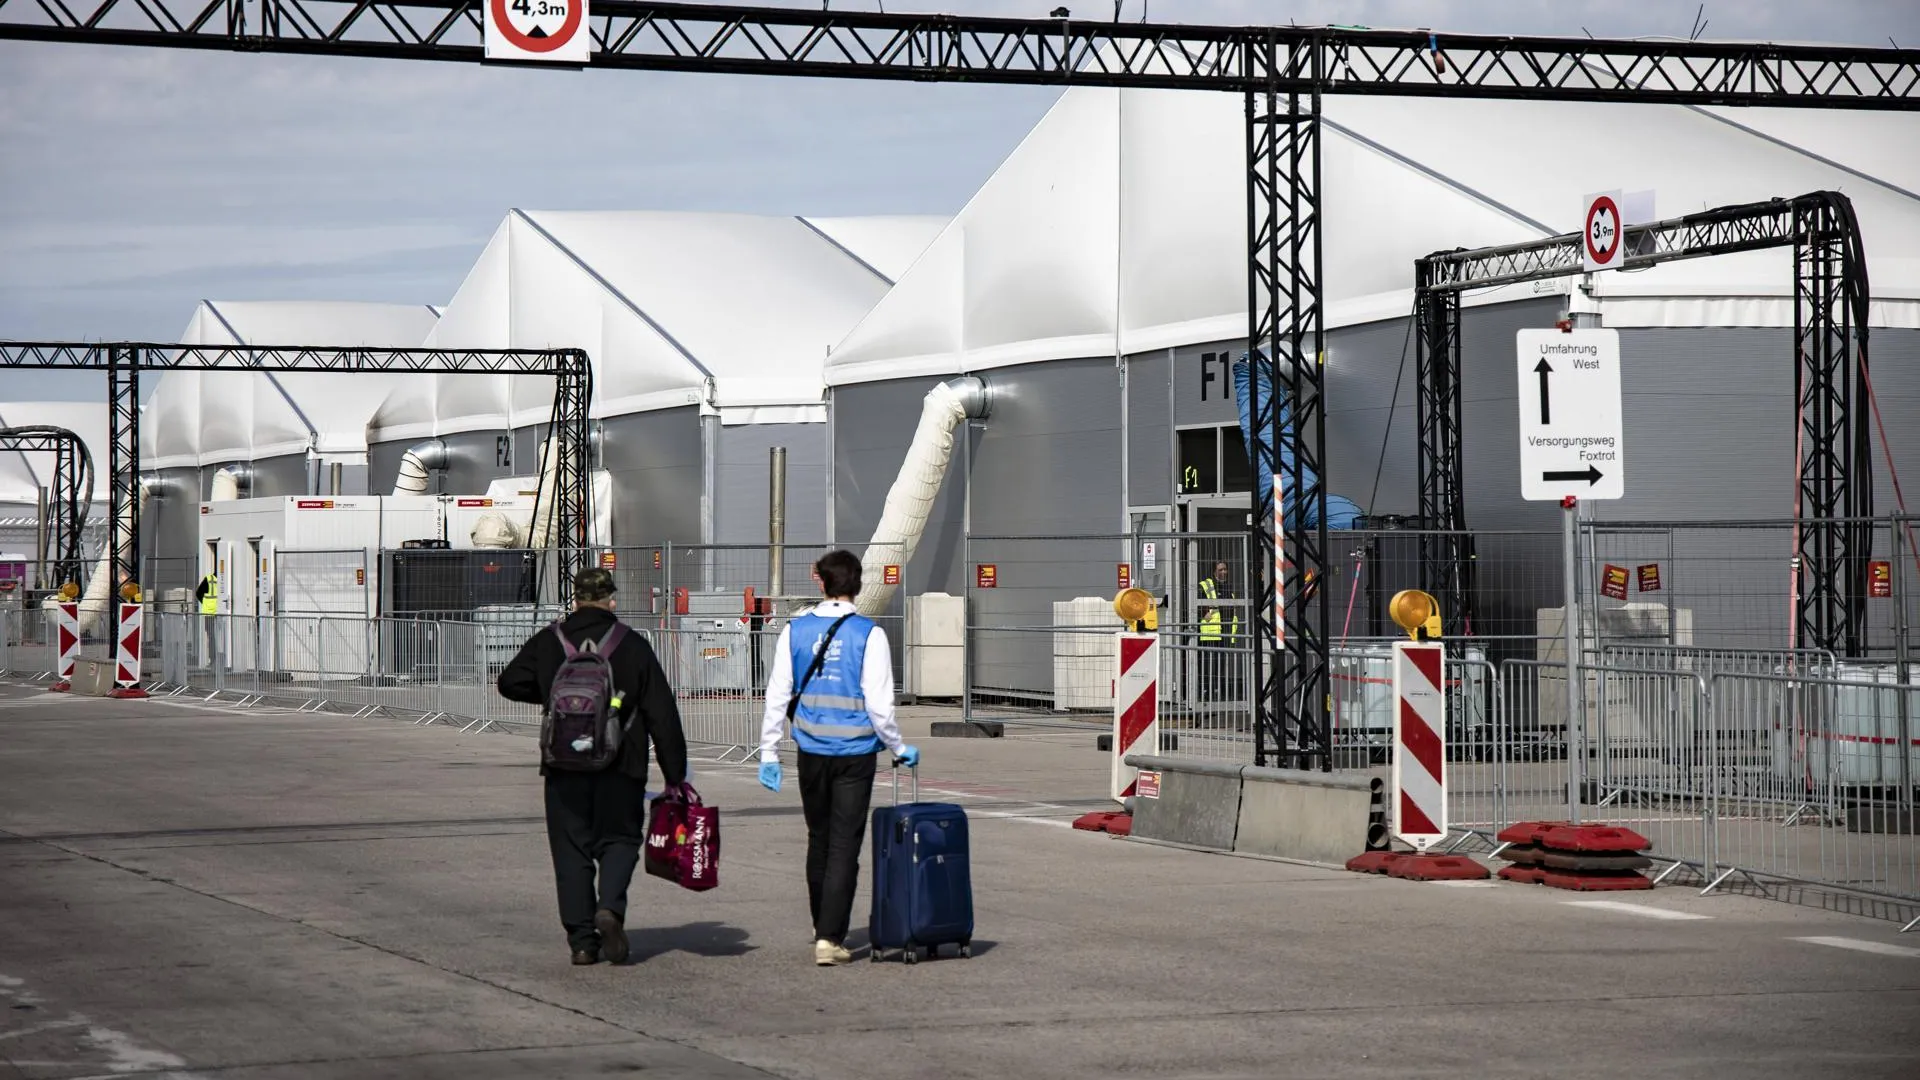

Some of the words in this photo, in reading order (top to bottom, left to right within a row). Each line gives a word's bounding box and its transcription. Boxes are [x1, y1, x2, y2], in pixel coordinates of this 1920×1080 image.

[1593, 221, 1614, 239] 3,9m
[1540, 344, 1597, 356] Umfahrung
[1573, 359, 1600, 369] West
[1201, 351, 1229, 401] F1
[496, 435, 510, 467] F2
[1528, 436, 1615, 448] Versorgungsweg
[1579, 450, 1615, 461] Foxtrot
[1185, 466, 1198, 488] F1
[692, 816, 706, 878] ROSSMANN
